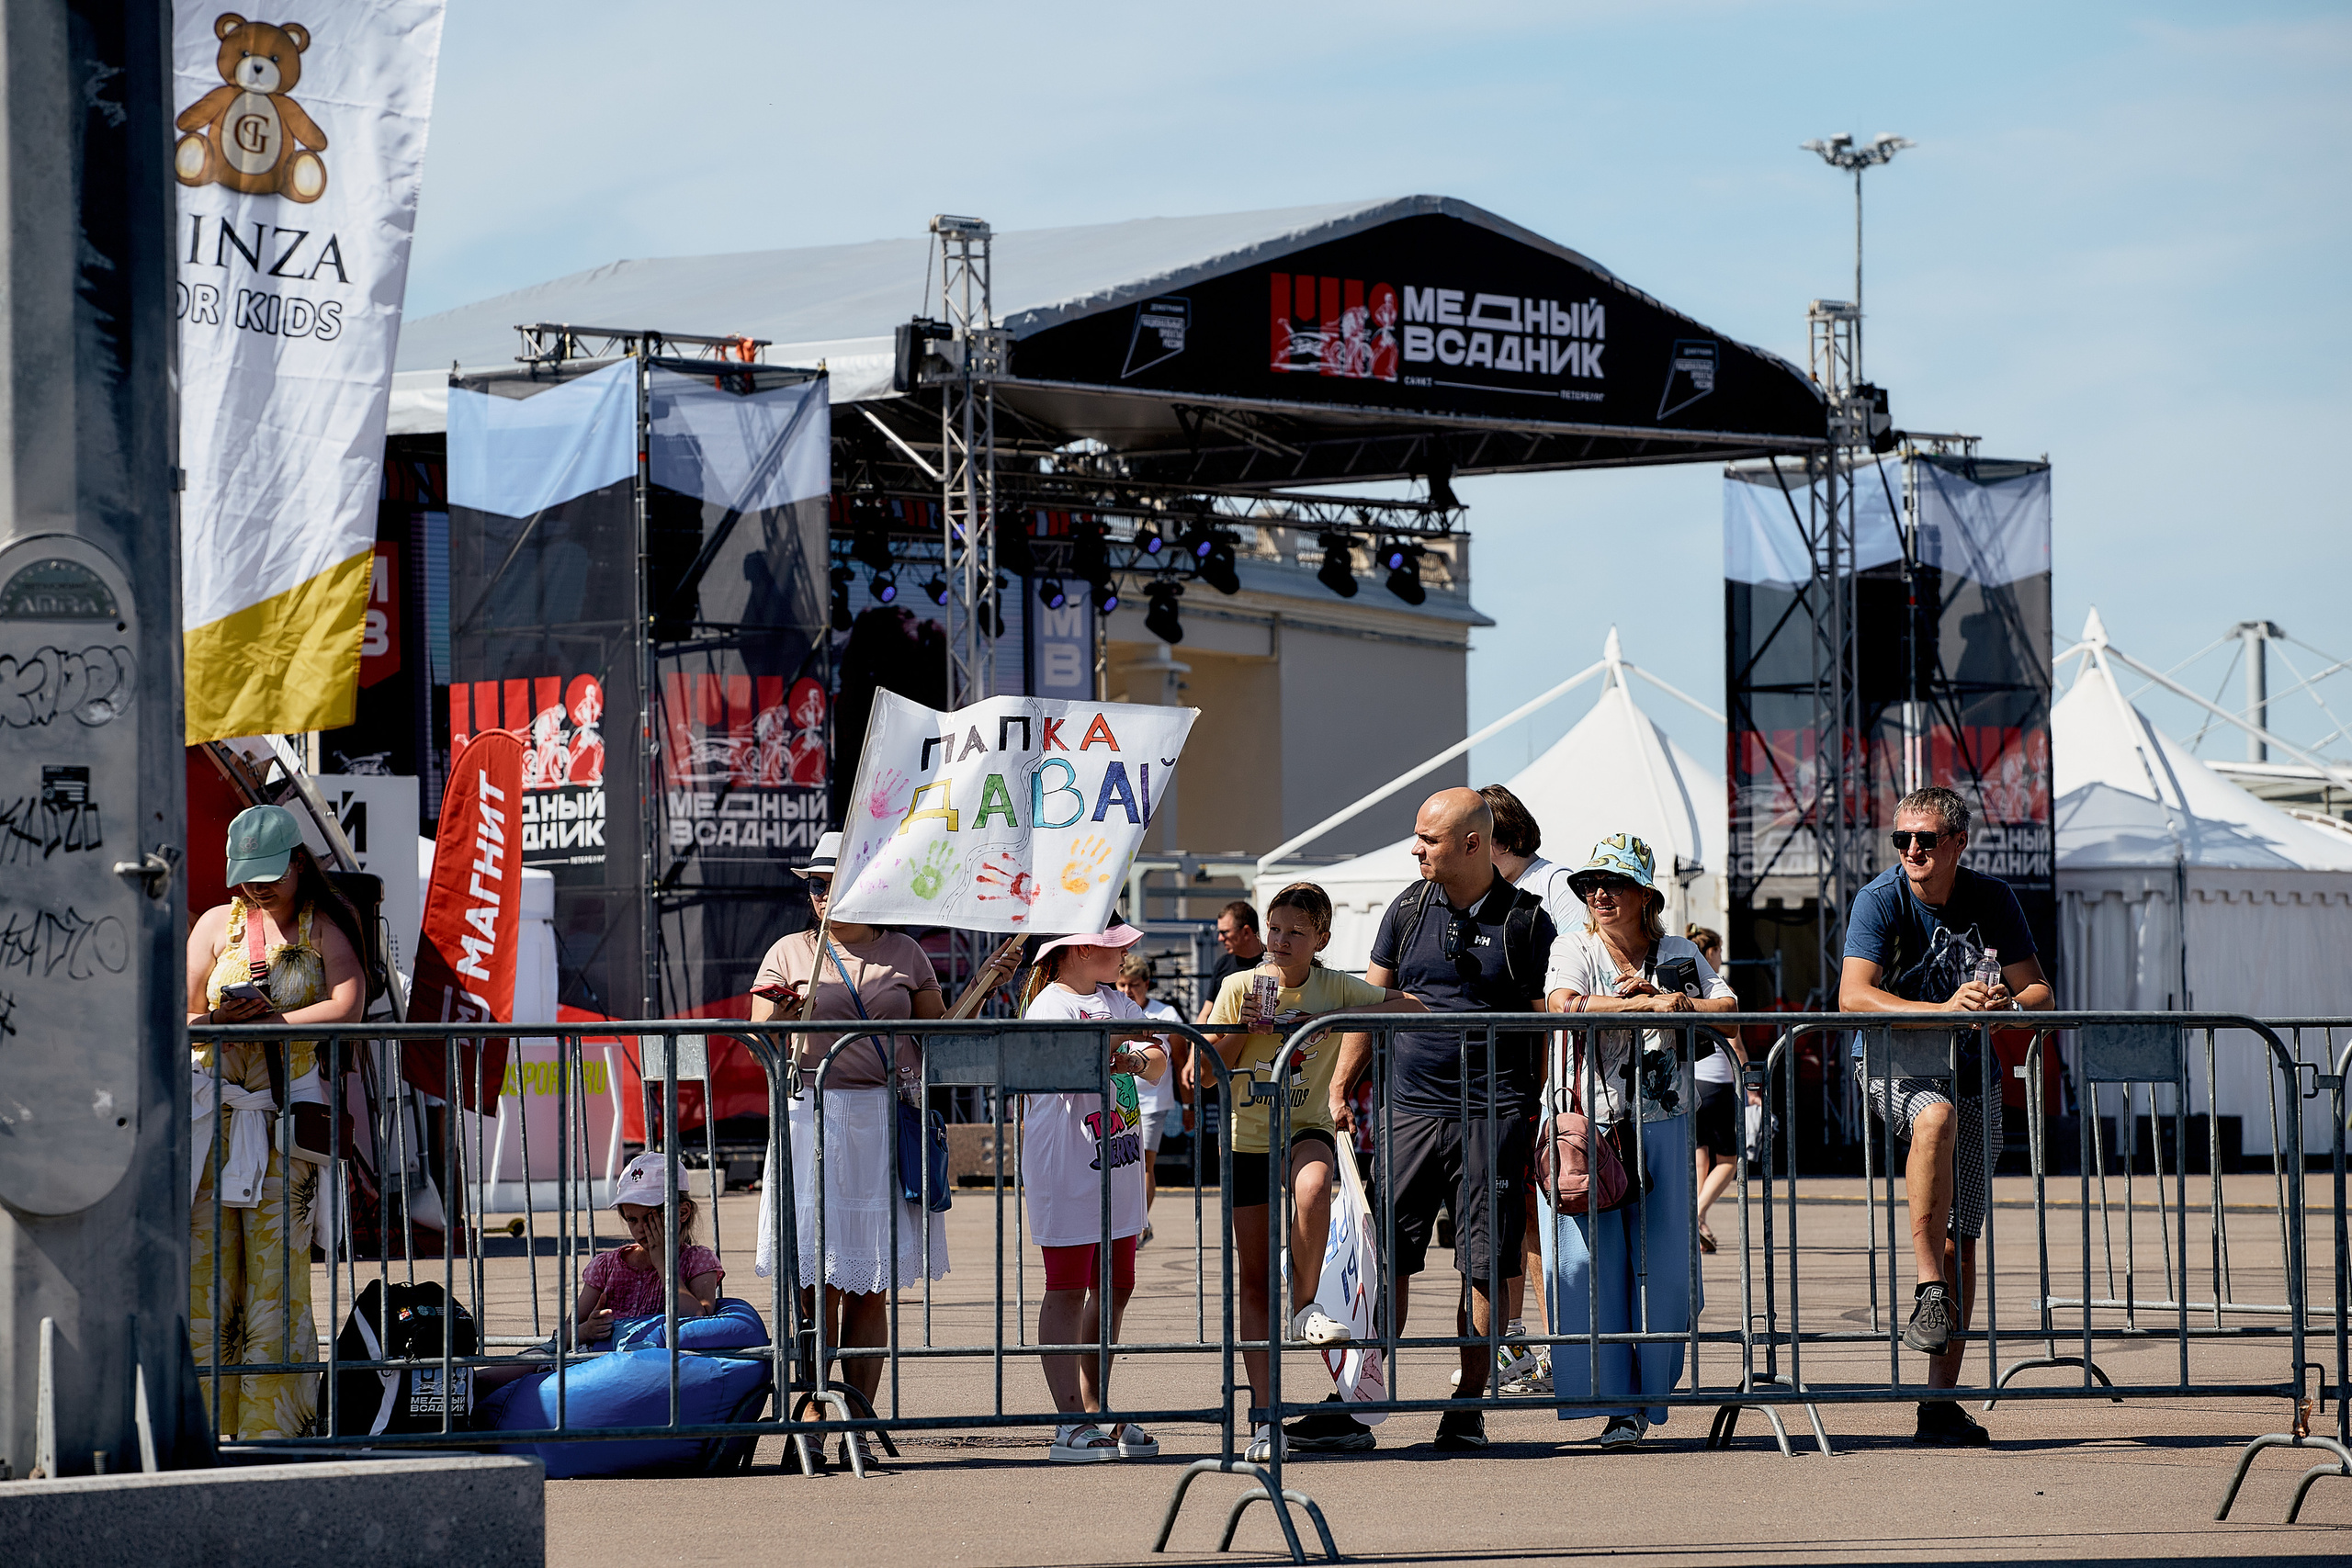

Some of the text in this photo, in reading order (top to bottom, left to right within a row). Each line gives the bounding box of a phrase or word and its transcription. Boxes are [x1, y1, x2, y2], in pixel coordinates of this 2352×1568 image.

[235, 288, 343, 342] KIDS
[1403, 285, 1606, 341] МЕДНЫЙ
[1403, 324, 1606, 379] ВСАДНИК
[921, 712, 1121, 773] ПАПКА
[669, 790, 827, 820] МЕДНЫЙ
[669, 819, 827, 848] ВСАДНИК
[456, 768, 505, 982] МАГНИТ
[410, 1404, 465, 1413] ВСАДИК
[411, 1394, 466, 1405] МЕДЫЙ
